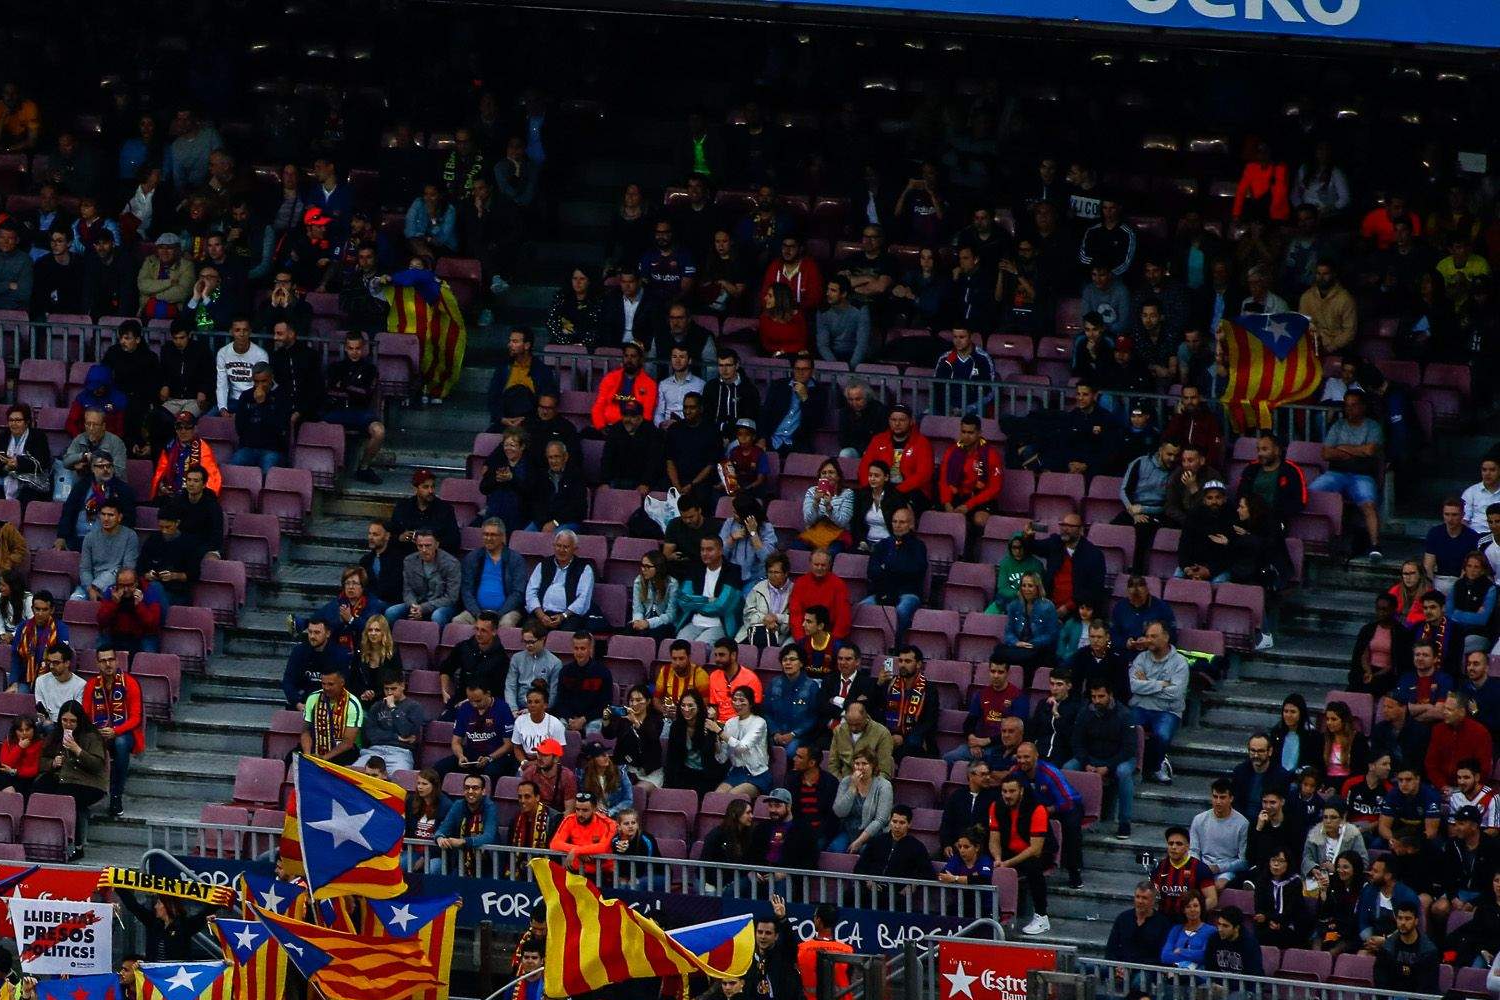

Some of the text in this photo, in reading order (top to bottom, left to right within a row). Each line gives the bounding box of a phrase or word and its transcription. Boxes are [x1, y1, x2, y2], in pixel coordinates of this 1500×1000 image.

[113, 867, 212, 901] LLIBERTAT
[23, 925, 95, 943] PRESOS
[980, 969, 1028, 991] Estre
